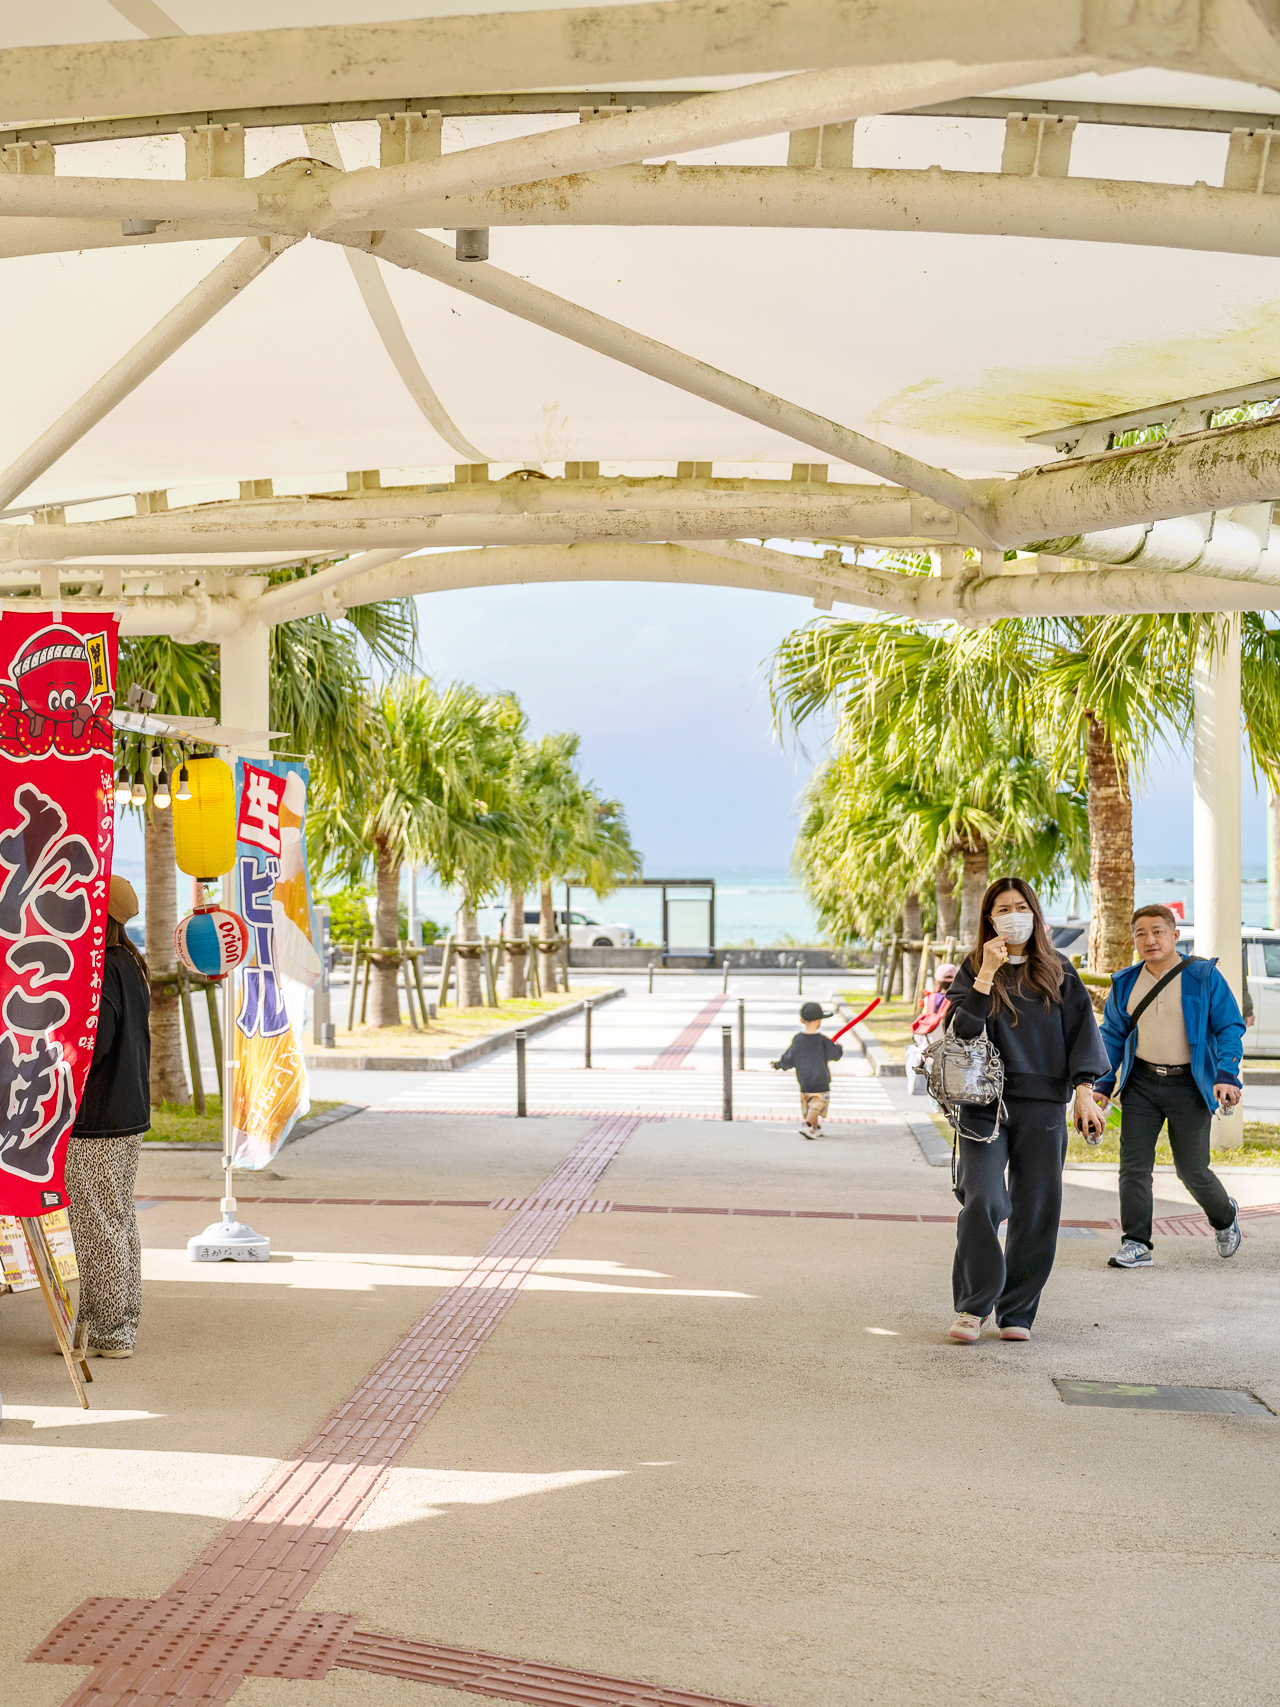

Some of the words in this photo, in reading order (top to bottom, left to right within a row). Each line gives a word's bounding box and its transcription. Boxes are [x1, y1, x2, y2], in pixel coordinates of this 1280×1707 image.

[219, 921, 241, 963] Orion
[201, 1247, 260, 1259] まかない家
